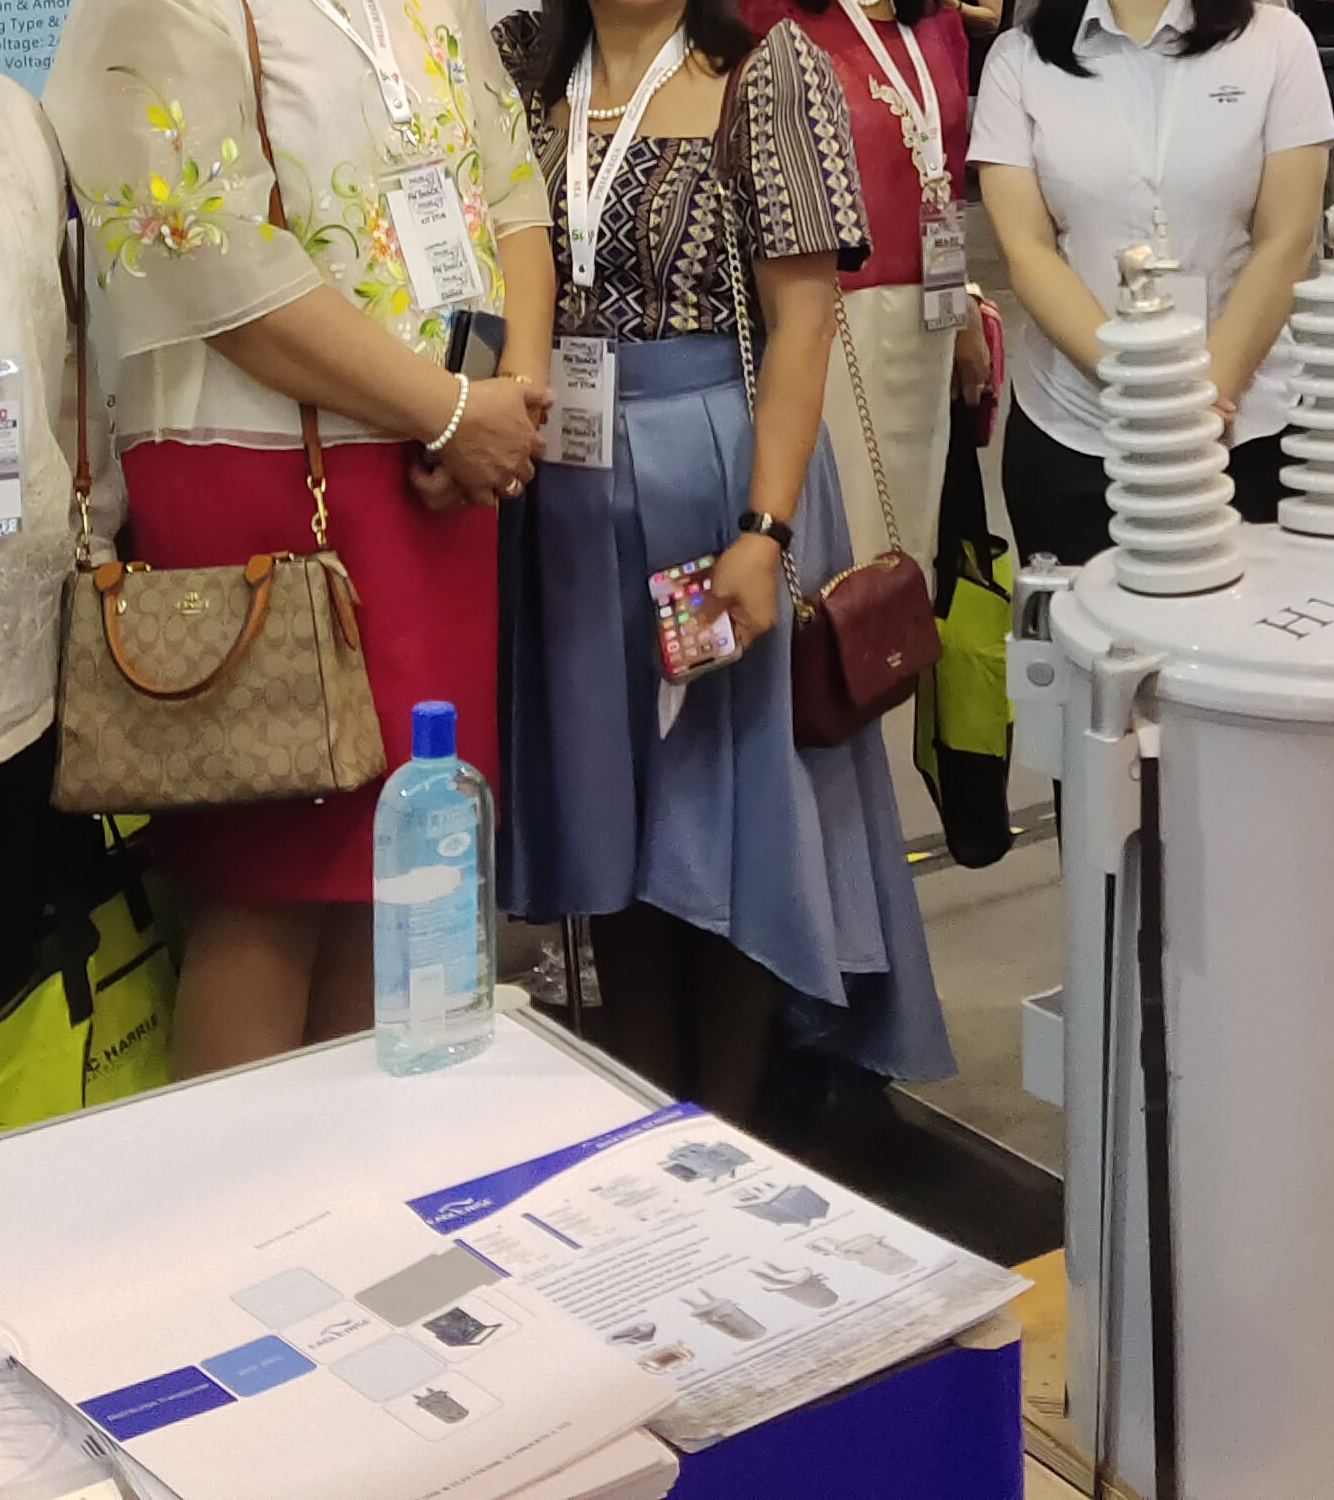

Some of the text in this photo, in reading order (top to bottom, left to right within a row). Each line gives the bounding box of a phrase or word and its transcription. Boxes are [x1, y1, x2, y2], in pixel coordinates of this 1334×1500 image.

[10, 17, 43, 33] Type
[48, 15, 60, 27] &
[4, 56, 54, 71] Voltag
